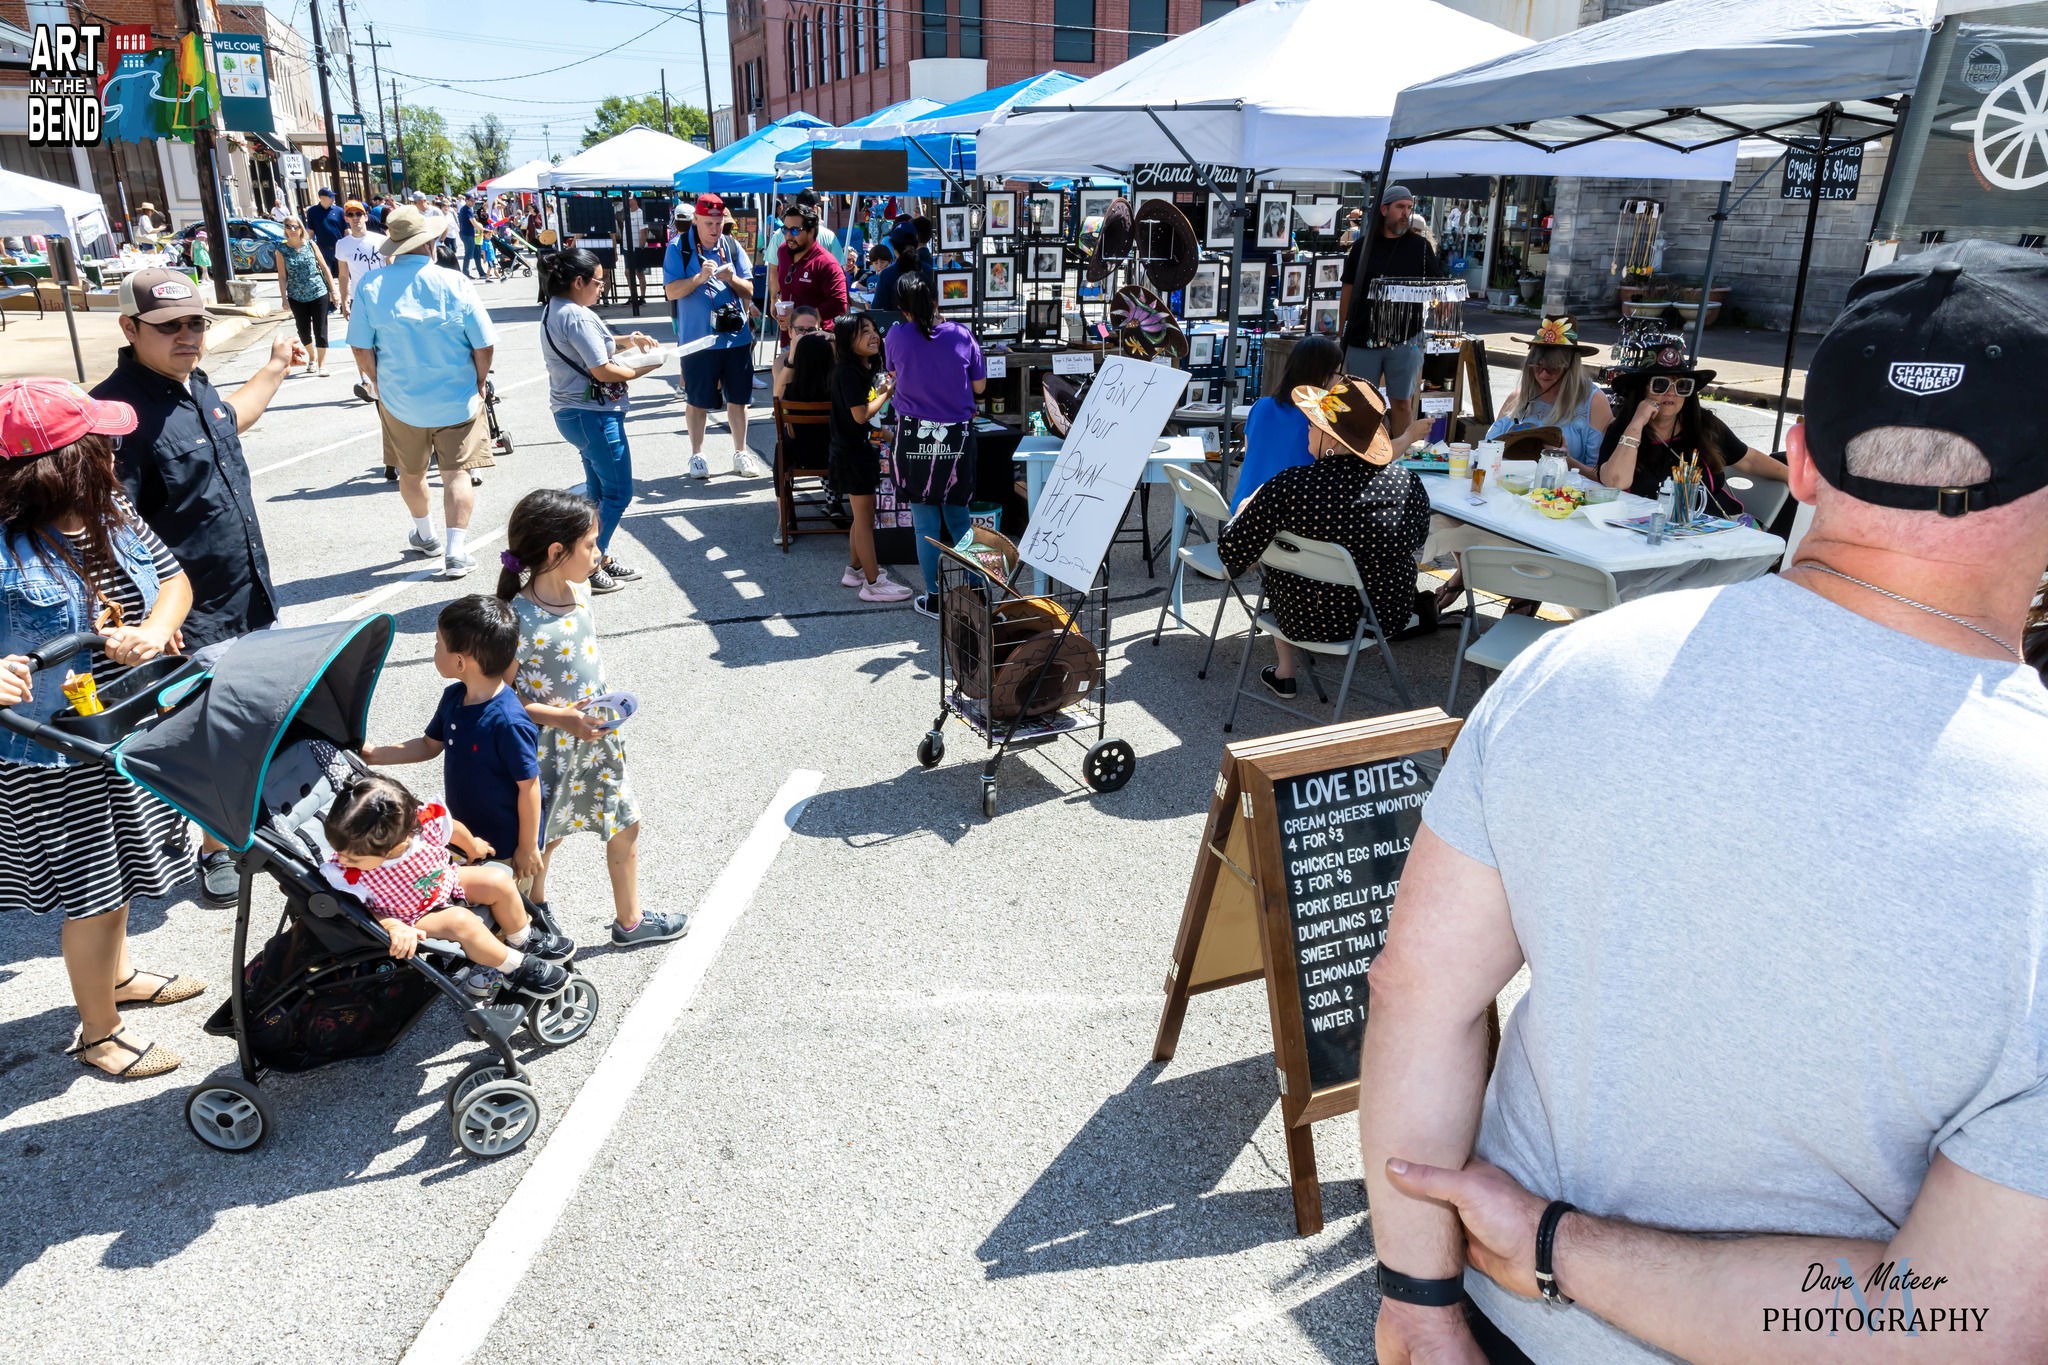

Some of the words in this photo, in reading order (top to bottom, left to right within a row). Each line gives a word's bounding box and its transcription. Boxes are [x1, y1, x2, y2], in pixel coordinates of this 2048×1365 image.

[215, 40, 260, 52] WELCOME
[1136, 163, 1194, 186] Hand
[1787, 158, 1817, 185] Cryst
[1823, 159, 1829, 181] &
[1832, 159, 1858, 182] Stone
[1784, 186, 1854, 199] JEWELRY
[1896, 366, 1958, 378] CHARTER
[1897, 375, 1951, 390] MEMBER
[919, 443, 951, 453] FLORIDA
[1041, 478, 1105, 529] HAT
[1023, 527, 1066, 562] $35
[1292, 772, 1350, 810] LOVE
[1354, 759, 1418, 797] BITES
[1284, 813, 1326, 835] CREAM
[1328, 802, 1375, 826] CHEESE
[1288, 837, 1298, 853] 4
[1302, 832, 1328, 851] FOR
[1328, 826, 1345, 843] $3
[1291, 851, 1344, 876] CHICKEN
[1347, 846, 1370, 864] EGG
[1373, 836, 1411, 859] ROLLS
[1294, 879, 1304, 896] 3
[1308, 873, 1335, 893] FOR
[1336, 868, 1353, 884] $6
[1296, 897, 1331, 919] PORK
[1333, 887, 1369, 910] BELLY
[1298, 911, 1367, 942] DUMPLINGS
[1369, 907, 1383, 924] 12
[1300, 940, 1343, 965] SWEET
[1345, 933, 1376, 953] THAI
[1304, 956, 1371, 988] LEMONADE
[1308, 988, 1341, 1010] SODA
[1344, 985, 1354, 1001] 2
[1311, 1008, 1355, 1033] WATER
[1358, 1005, 1366, 1021] 1
